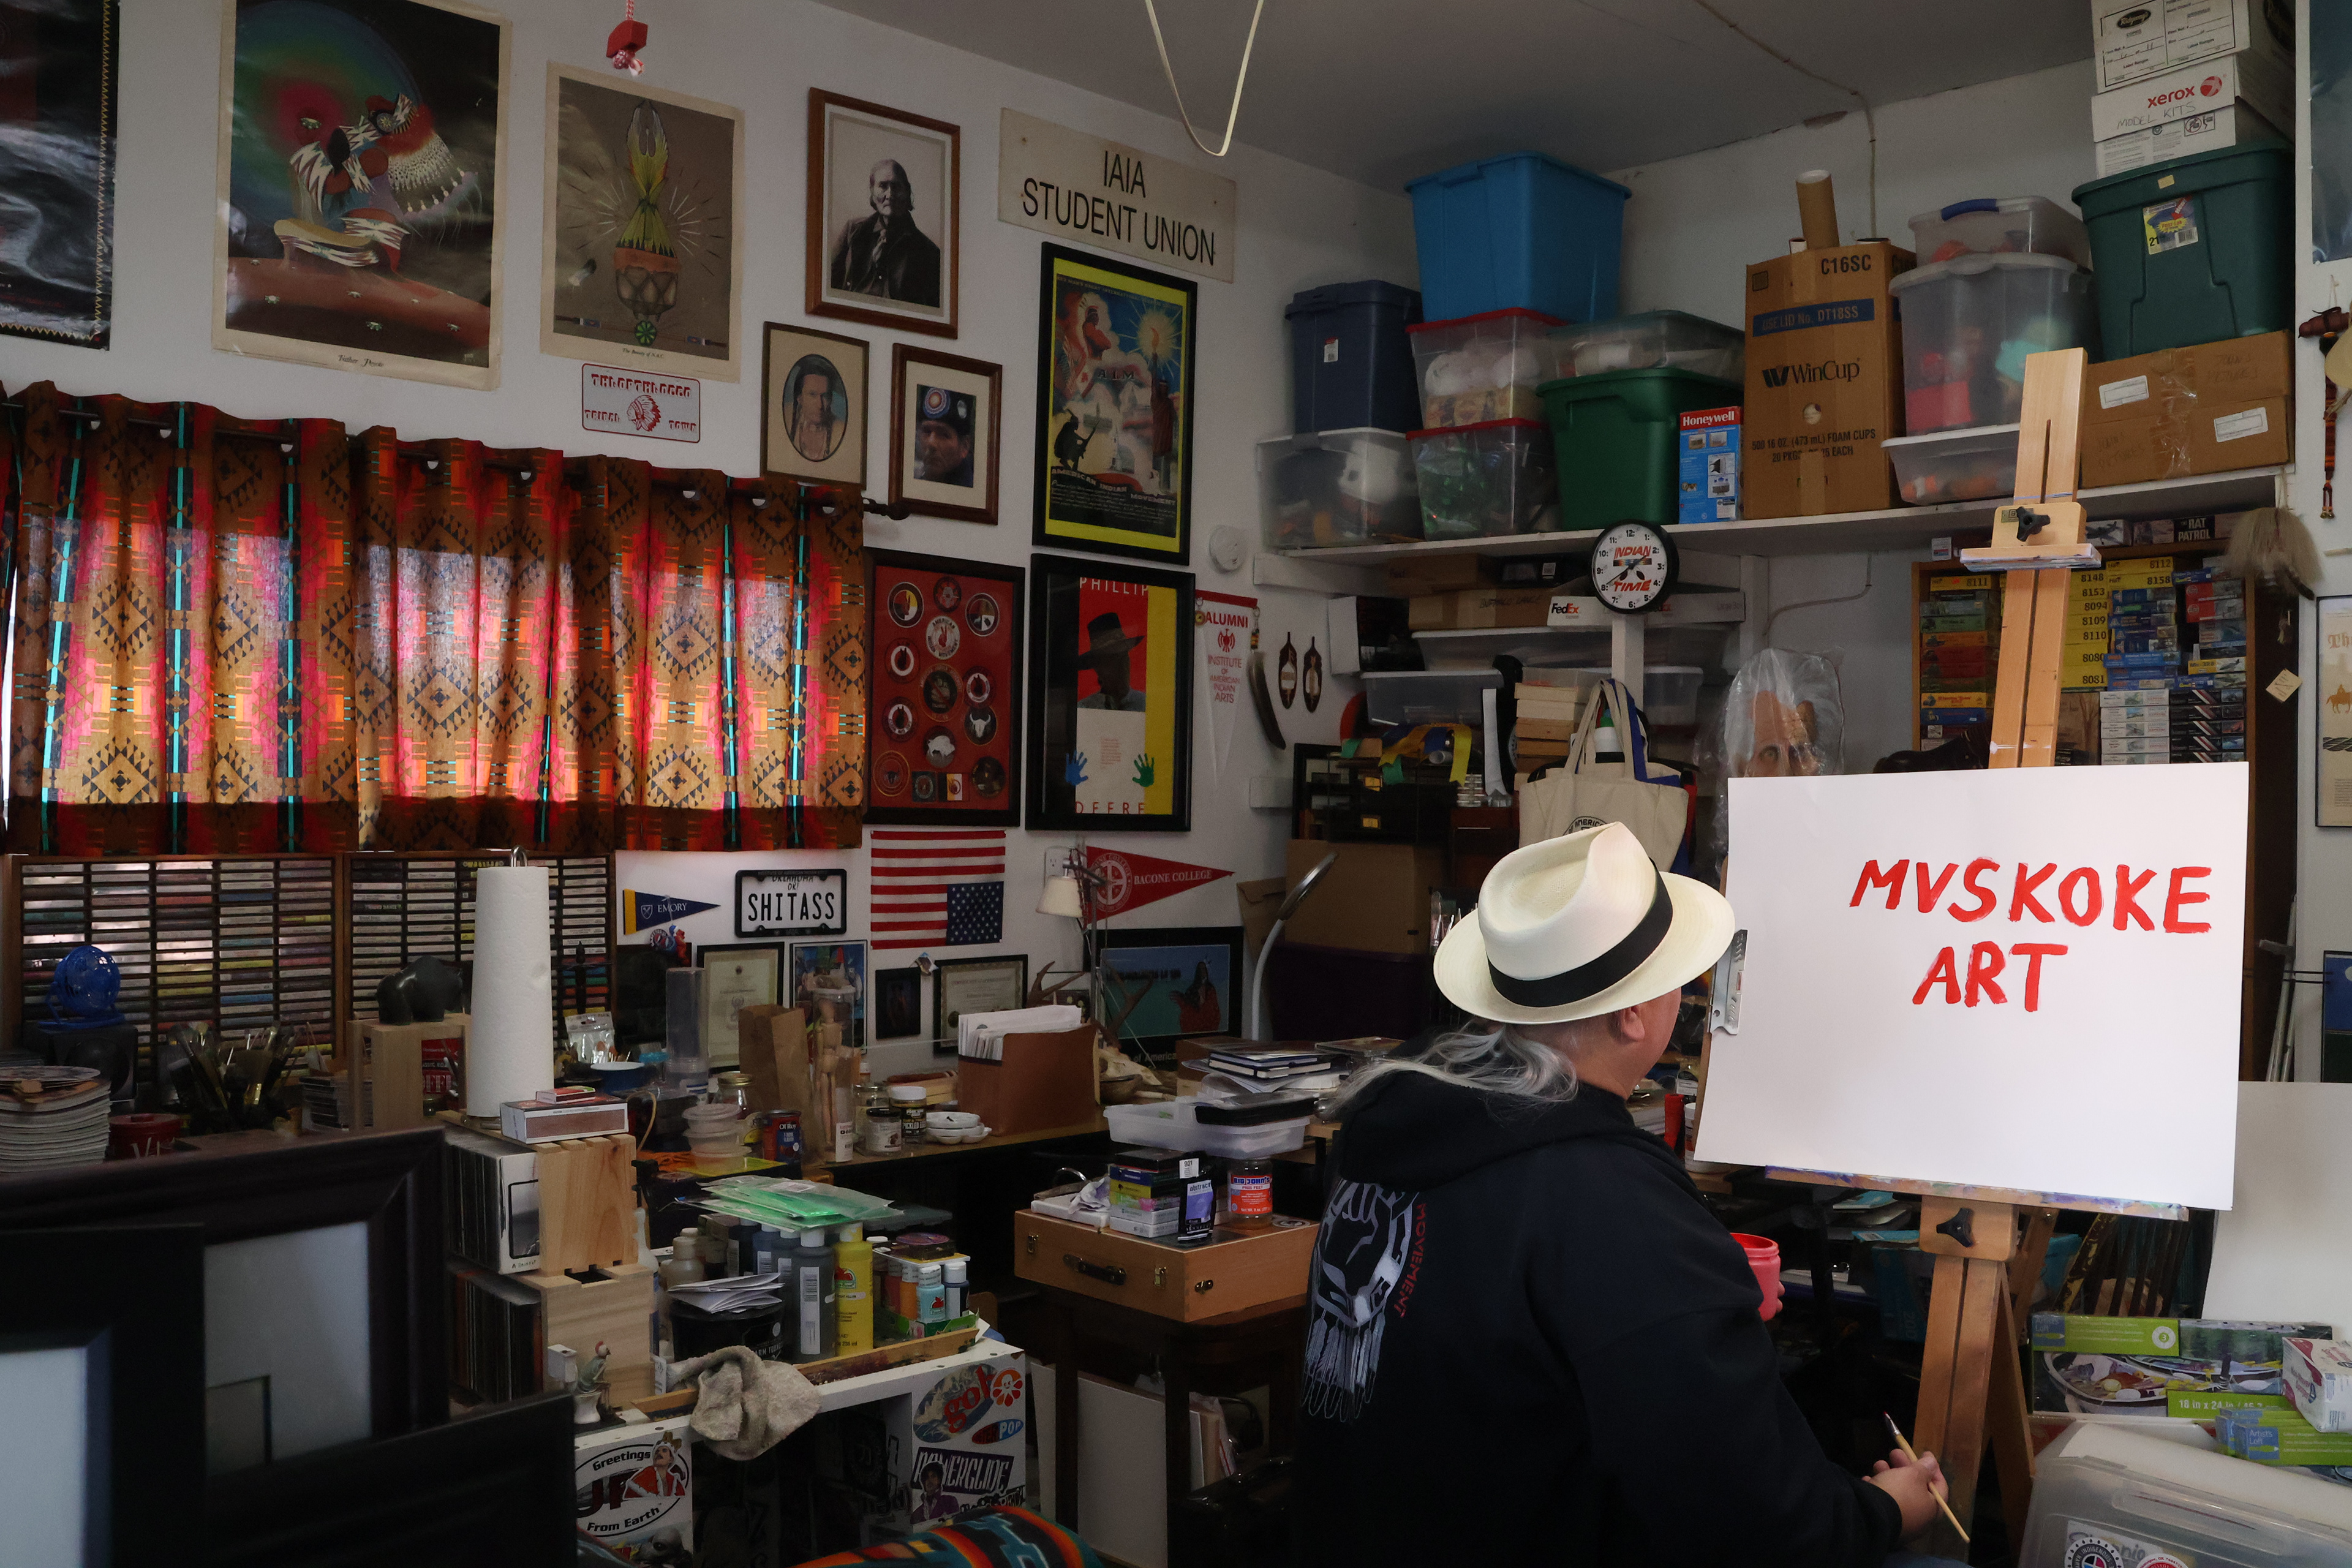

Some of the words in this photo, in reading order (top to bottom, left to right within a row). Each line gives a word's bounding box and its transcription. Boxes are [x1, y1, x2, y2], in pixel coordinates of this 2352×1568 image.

[2148, 86, 2195, 108] xerox
[2117, 115, 2157, 129] MODEL
[2164, 102, 2196, 118] KITS
[1104, 150, 1145, 198] IAIA
[1023, 178, 1137, 243] STUDENT
[1144, 212, 1214, 266] UNION
[1821, 254, 1872, 275] C16SC
[1780, 314, 1795, 328] LID
[1818, 306, 1859, 322] DT18SS
[1792, 360, 1860, 383] WinCup
[584, 409, 620, 423] TRIBAL
[669, 420, 696, 432] TOWN
[1683, 410, 1735, 427] Honeywell
[1767, 439, 1776, 450] 16
[1828, 431, 1851, 443] FOAM
[1853, 429, 1877, 441] CUPS
[1832, 445, 1854, 456] EACH
[2188, 518, 2206, 529] RAT
[2177, 530, 2211, 542] PATROL
[1614, 545, 1651, 559] INDIAN
[2150, 559, 2171, 569] 8112
[1967, 578, 1988, 587] 8111
[2081, 573, 2104, 582] 8148
[2147, 576, 2171, 585] 8158
[1080, 577, 1148, 596] PHILLIP
[1613, 579, 1652, 592] TIME
[2082, 587, 2105, 597] 8153
[1551, 603, 1579, 614] FedEx
[2084, 601, 2108, 611] 8094
[1205, 611, 1248, 628] ALUMNI
[2082, 616, 2106, 626] 8109
[2083, 631, 2106, 641] 8110
[1208, 655, 1242, 668] INSTITUTE
[1210, 674, 1240, 685] AMERICAN
[2082, 675, 2105, 684] 8081
[1213, 683, 1235, 693] INDIAN
[1215, 692, 1234, 704] ARTS
[1134, 873, 1170, 885] BACONE
[1172, 870, 1213, 882] COLLEGE
[1849, 856, 2212, 933] MVSKOKE
[657, 902, 687, 913] EMORY
[748, 892, 835, 921] SHITASS
[1912, 941, 2068, 1012] ART
[1246, 1176, 1271, 1185] JOHN'S
[1189, 1182, 1211, 1193] abstract
[1393, 1202, 1427, 1319] MOVEMENT
[2179, 1400, 2190, 1408] 18
[2193, 1399, 2201, 1408] in
[2211, 1401, 2222, 1409] 24
[592, 1450, 651, 1471] Greetings
[587, 1522, 620, 1532] From
[624, 1507, 660, 1528] Earth
[2081, 1546, 2112, 1562] INDIGENOUS
